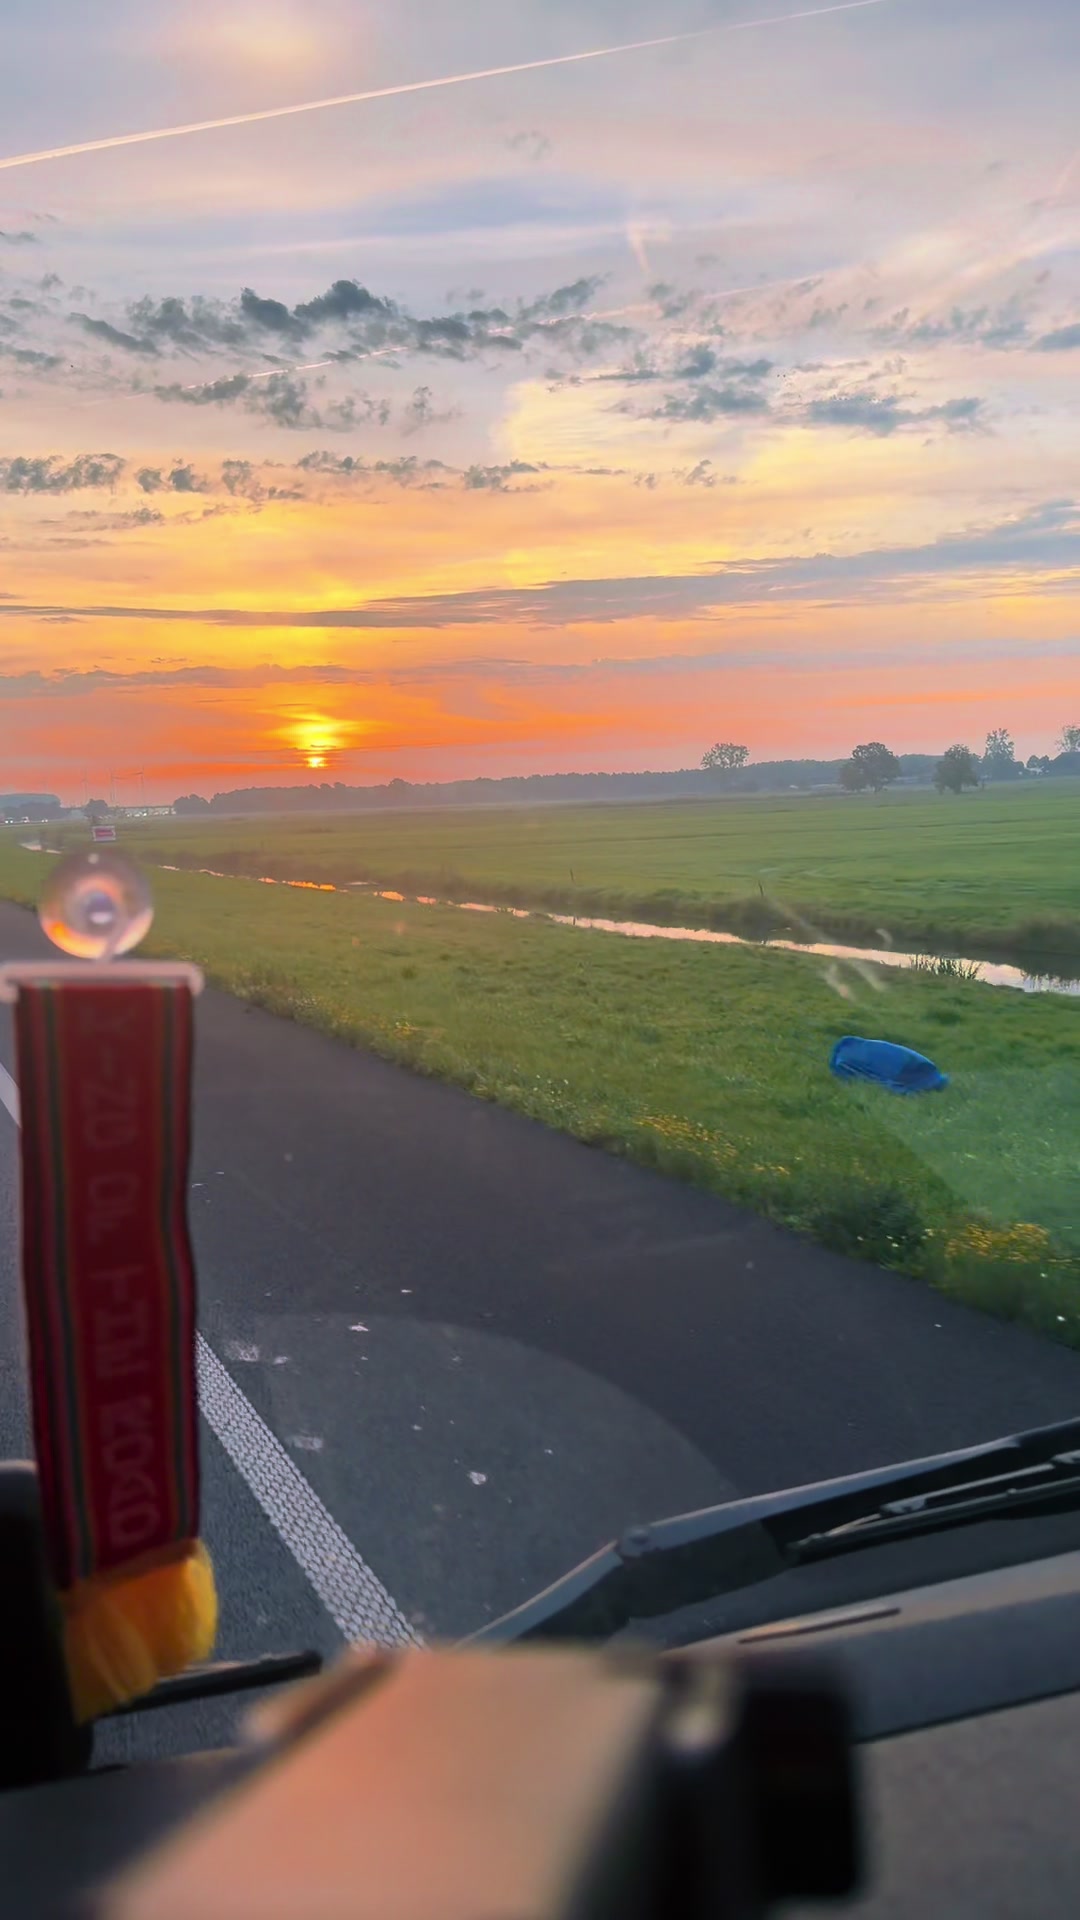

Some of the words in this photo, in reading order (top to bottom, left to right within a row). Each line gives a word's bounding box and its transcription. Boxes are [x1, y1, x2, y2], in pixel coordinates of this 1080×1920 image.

[87, 1171, 140, 1246] OF
[87, 1264, 148, 1378] THE
[97, 1393, 159, 1548] ROAD
